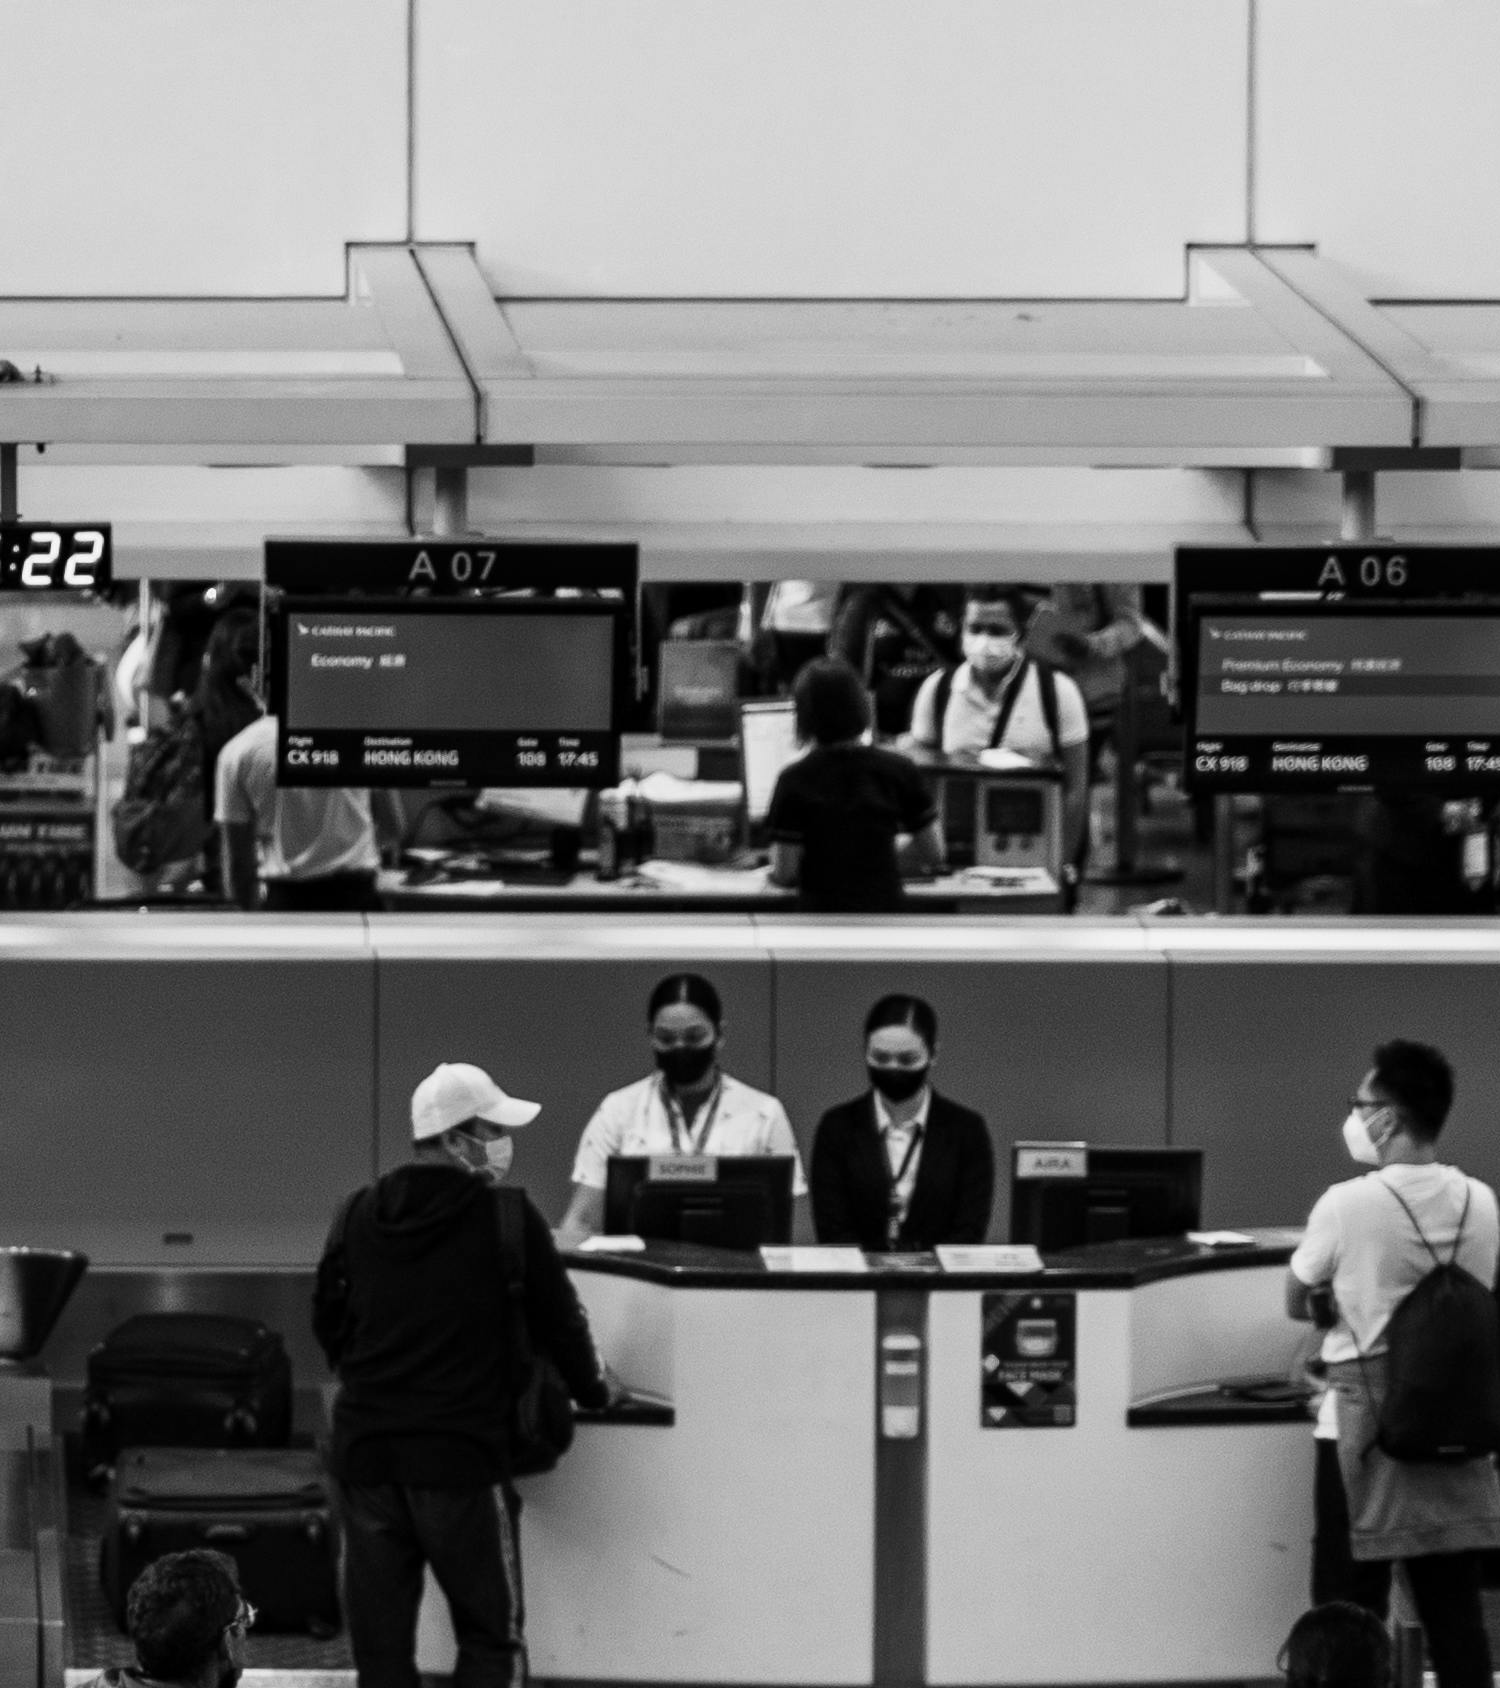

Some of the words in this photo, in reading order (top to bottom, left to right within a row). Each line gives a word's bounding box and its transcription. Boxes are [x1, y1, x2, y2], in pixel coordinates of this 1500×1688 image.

[408, 550, 437, 581] A
[451, 551, 496, 582] 07
[1318, 555, 1345, 586] A
[1360, 555, 1408, 586] 06
